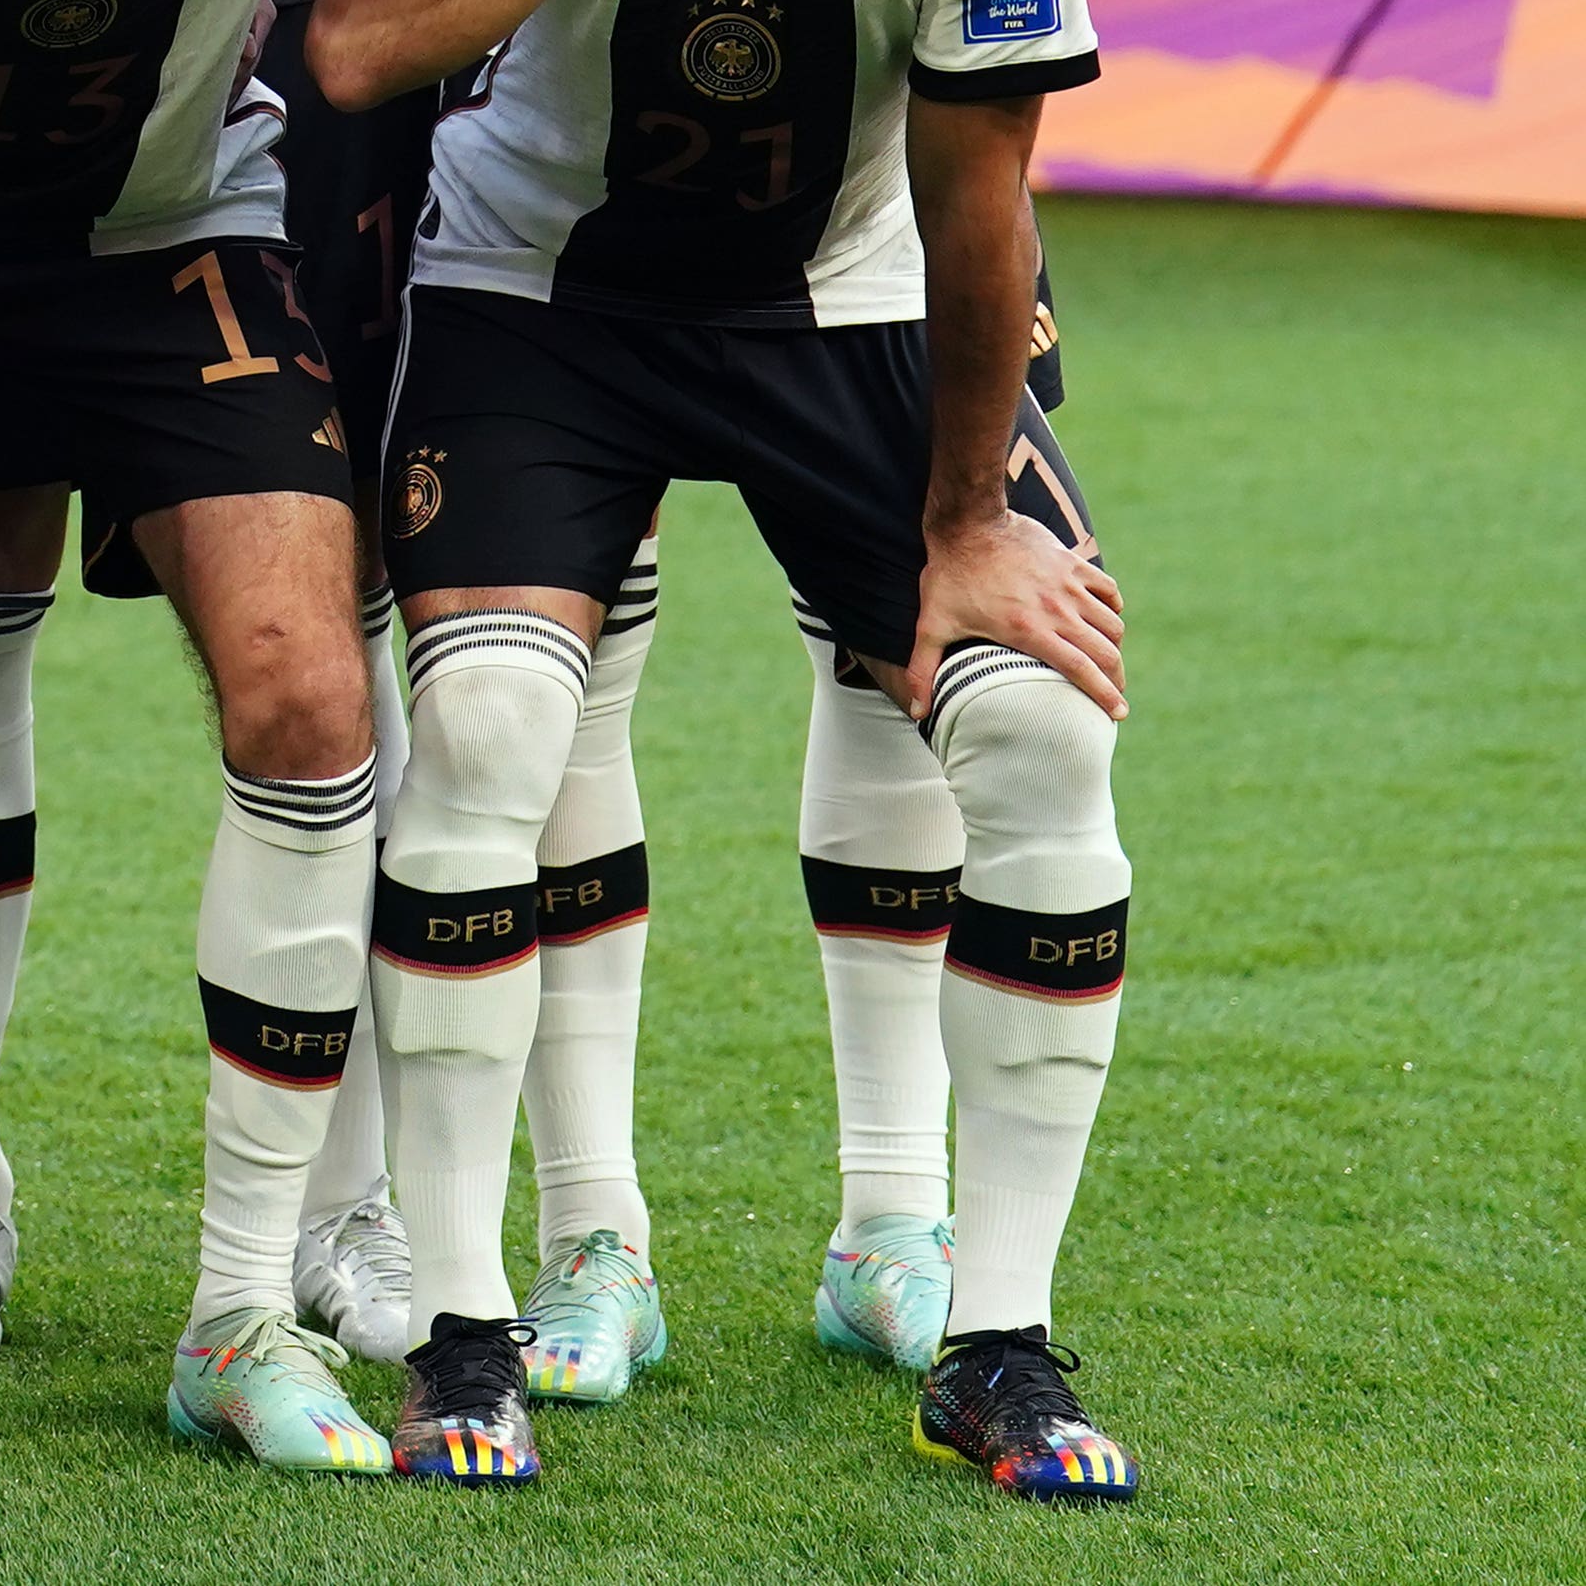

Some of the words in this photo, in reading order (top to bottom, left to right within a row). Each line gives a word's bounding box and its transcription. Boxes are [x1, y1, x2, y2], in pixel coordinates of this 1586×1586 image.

[988, 4, 1006, 18] the
[1007, 1, 1038, 17] World
[1004, 20, 1025, 29] FIFA
[704, 24, 760, 44] DEUTSCHER
[636, 110, 794, 212] 21
[535, 878, 604, 914] FB
[426, 908, 514, 942] DFB
[1028, 928, 1118, 966] DFB
[261, 1024, 347, 1056] DFB
